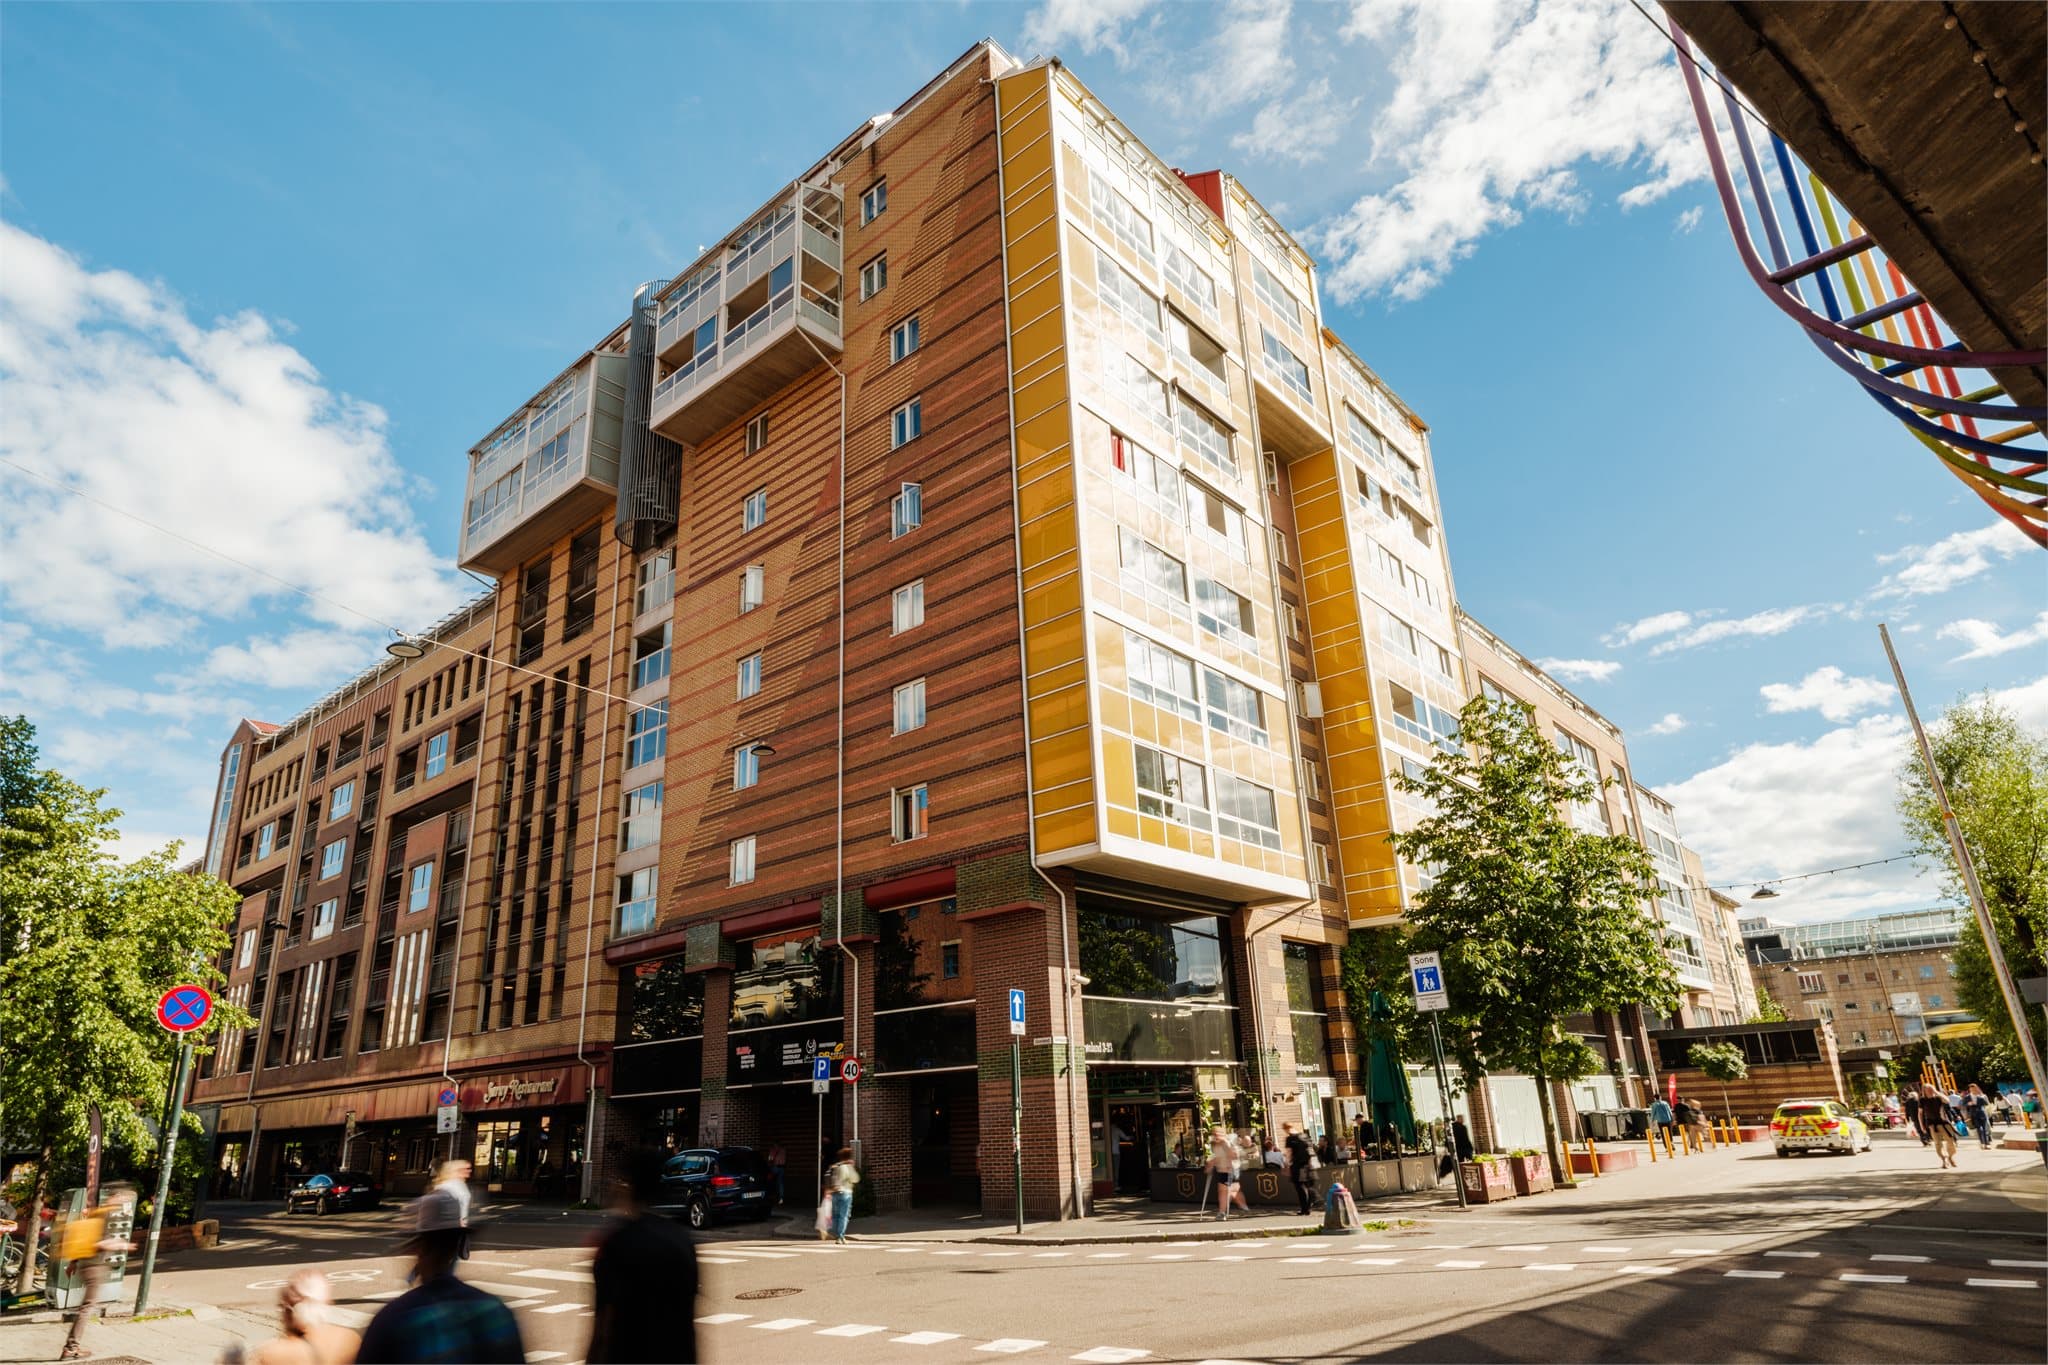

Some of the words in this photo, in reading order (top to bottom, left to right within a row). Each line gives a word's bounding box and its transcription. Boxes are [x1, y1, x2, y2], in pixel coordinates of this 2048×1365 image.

[1414, 956, 1434, 964] Sone
[817, 1060, 827, 1077] P
[844, 1063, 858, 1077] 40
[509, 1078, 555, 1101] Restaurant
